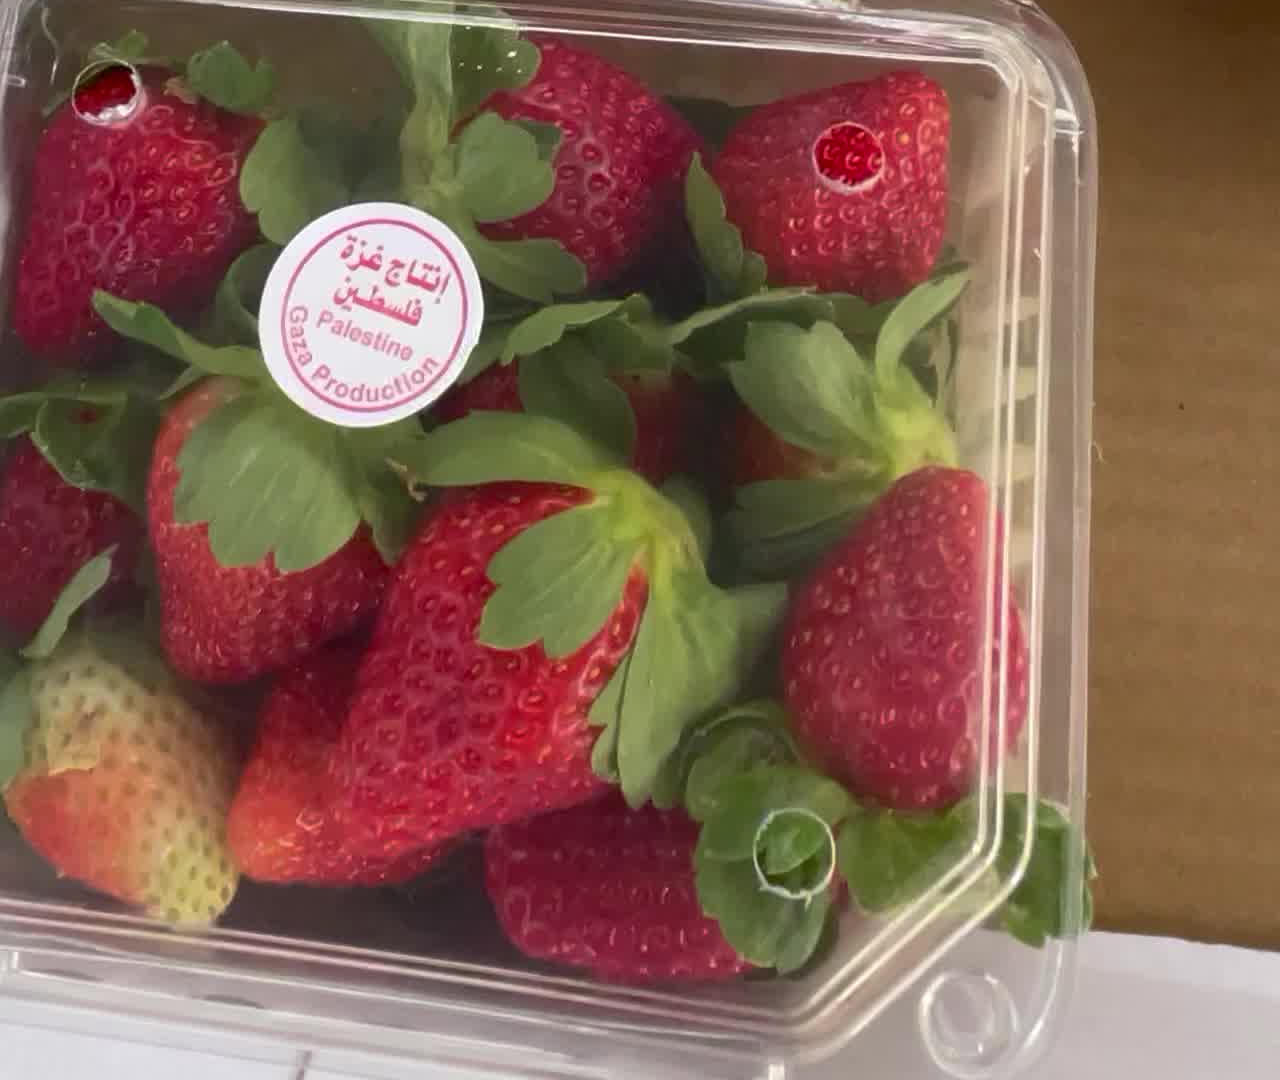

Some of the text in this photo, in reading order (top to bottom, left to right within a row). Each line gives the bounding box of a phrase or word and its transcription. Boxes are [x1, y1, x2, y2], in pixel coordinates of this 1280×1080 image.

[339, 234, 451, 304] إنتاج غزة
[332, 275, 424, 326] فلسطين
[289, 304, 439, 403] Gaza Production
[315, 310, 414, 361] Palestine
